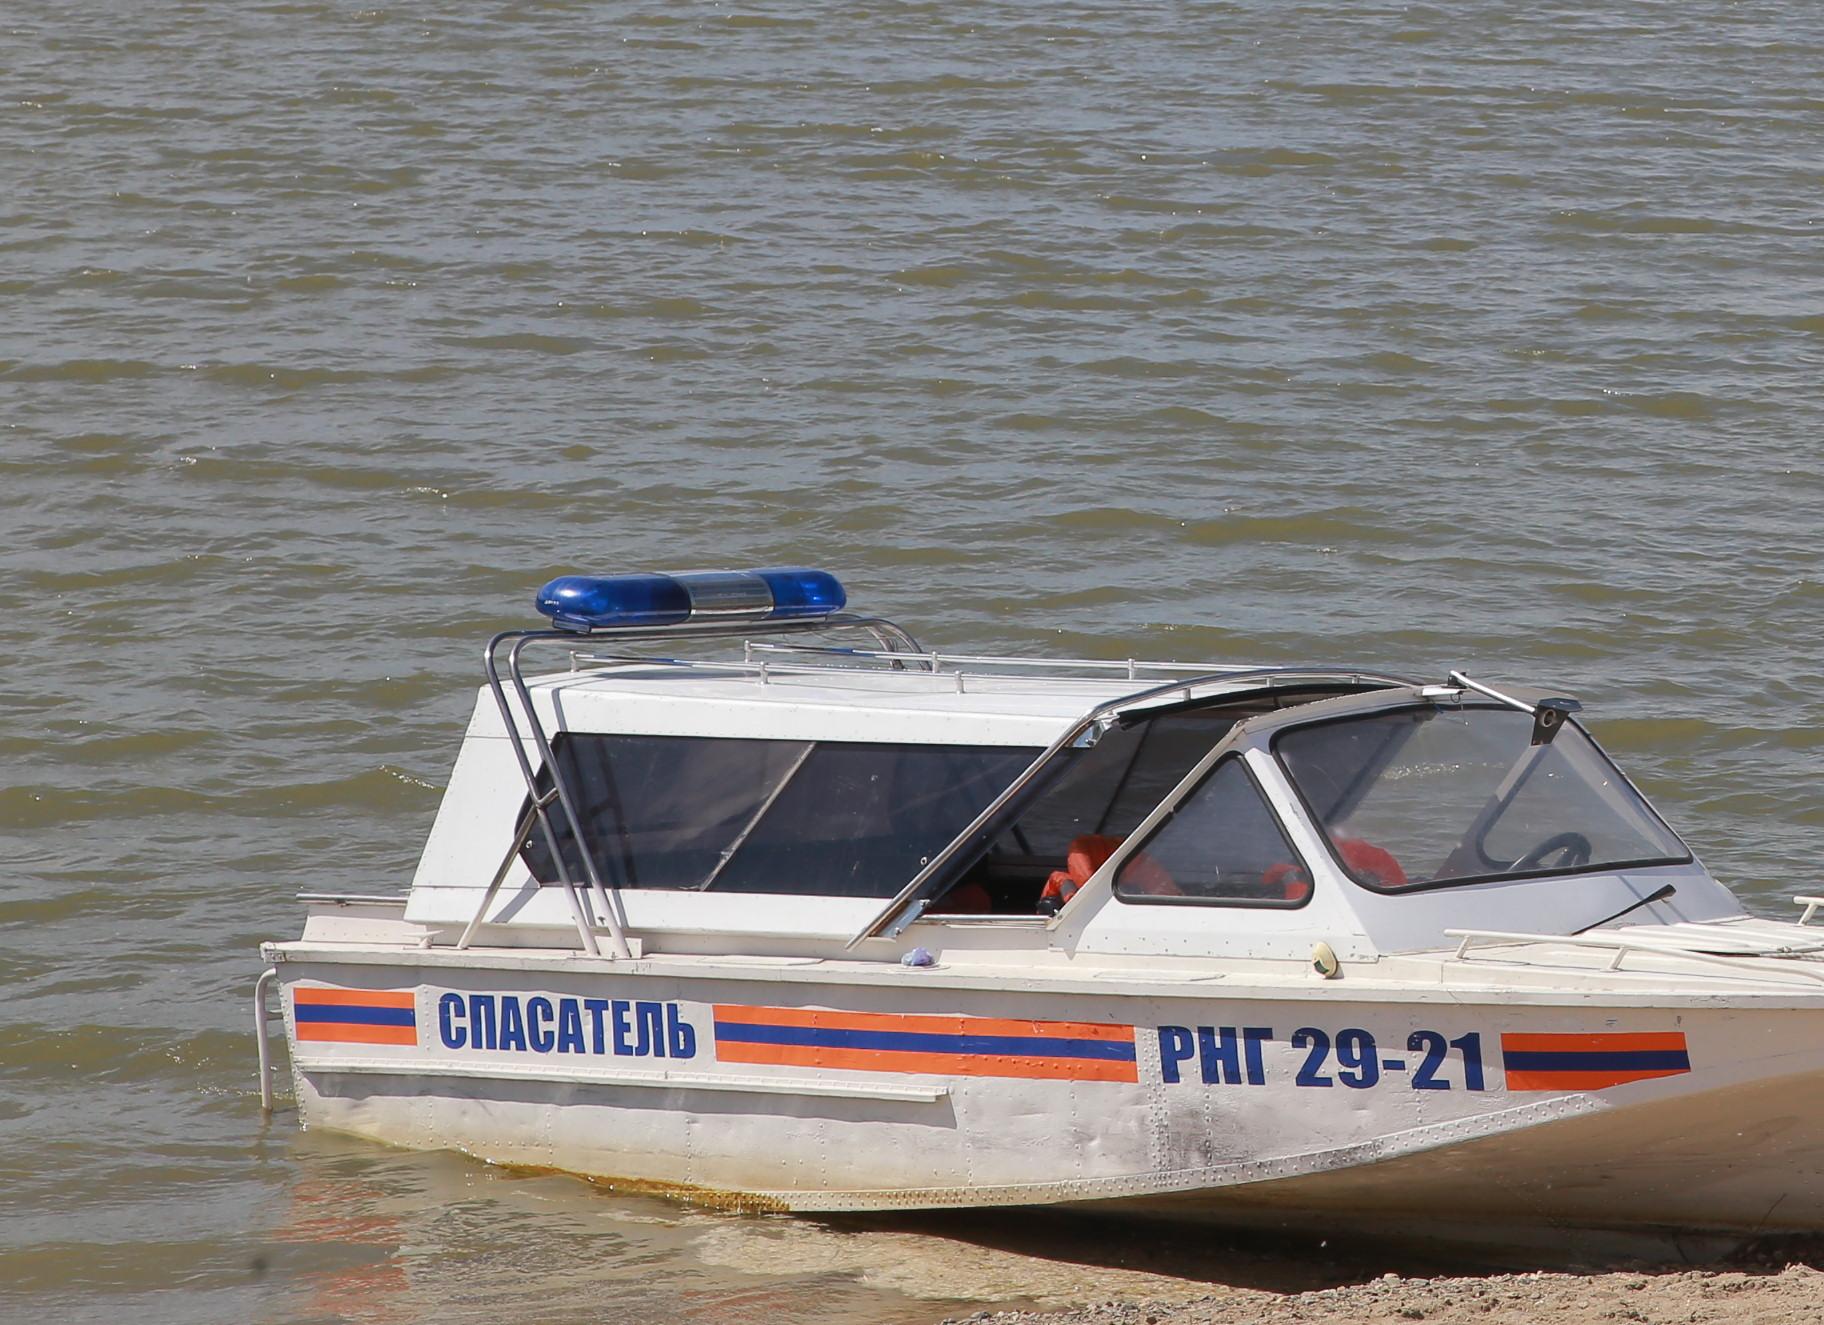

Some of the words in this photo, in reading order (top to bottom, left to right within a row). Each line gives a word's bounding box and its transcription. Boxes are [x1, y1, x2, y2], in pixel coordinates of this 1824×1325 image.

[439, 992, 696, 1059] СПАСАТЕЛЬ
[1157, 1025, 1273, 1086] РНГ
[1291, 1027, 1486, 1091] 29-21
